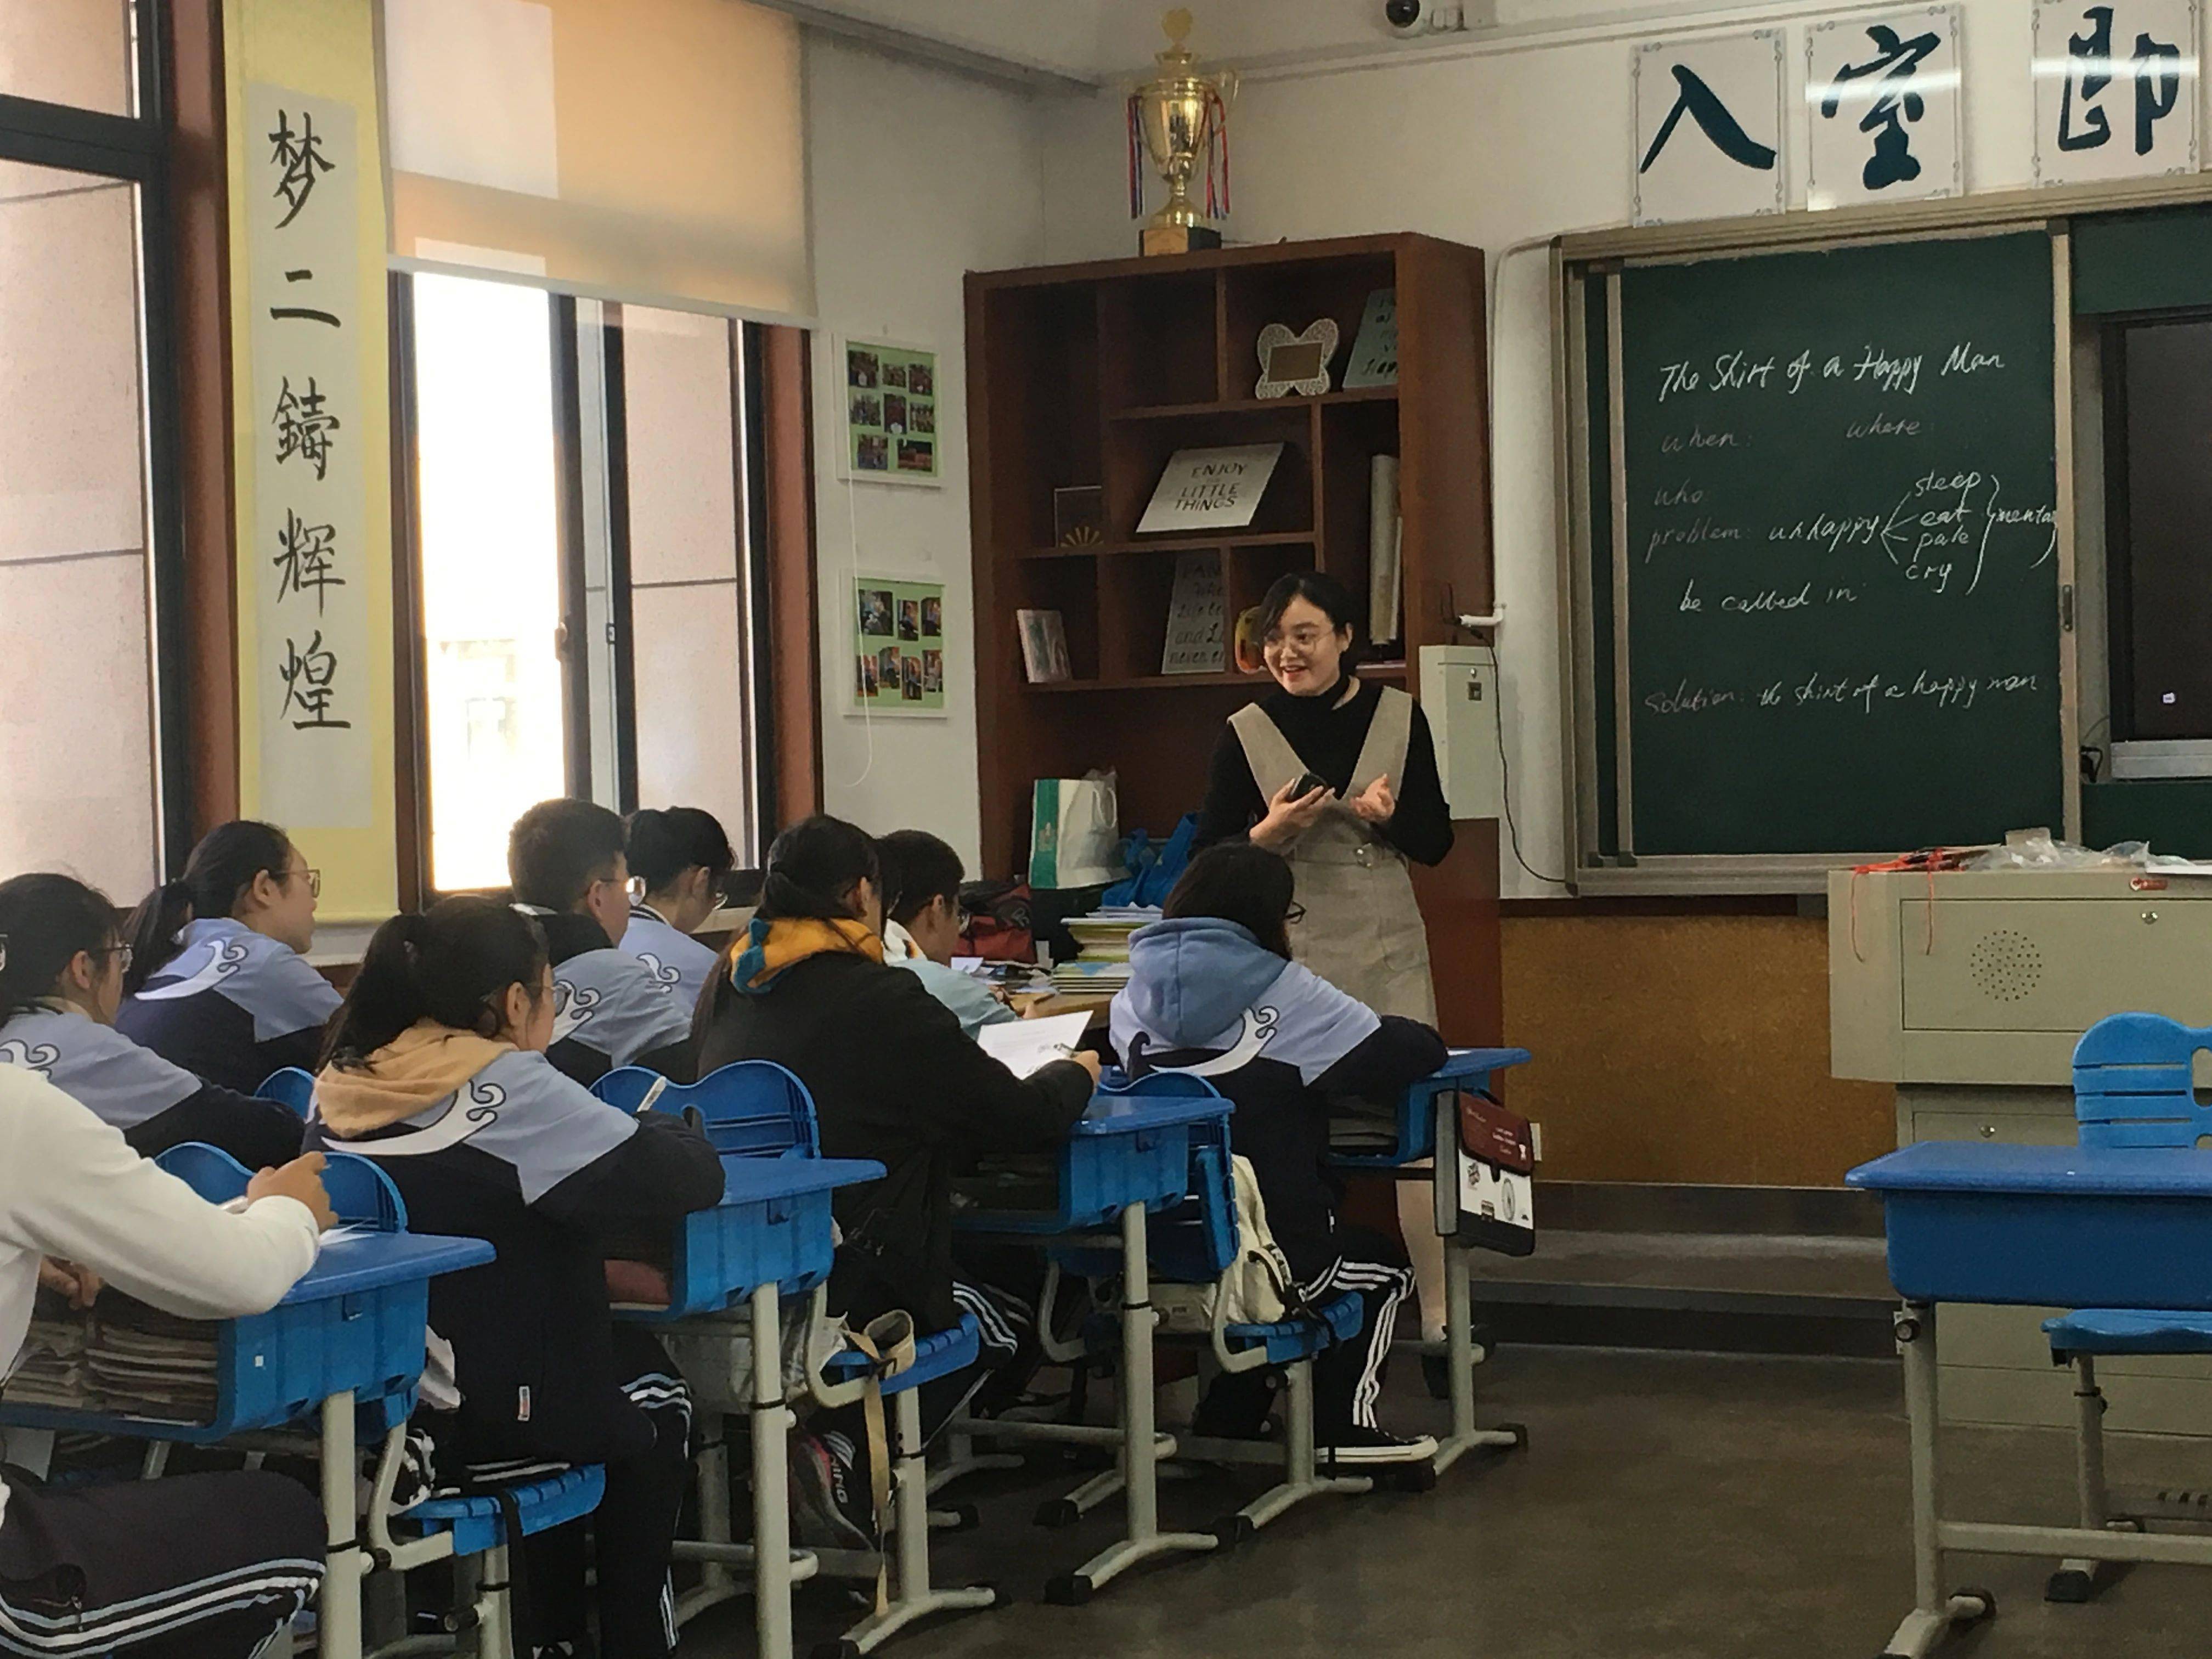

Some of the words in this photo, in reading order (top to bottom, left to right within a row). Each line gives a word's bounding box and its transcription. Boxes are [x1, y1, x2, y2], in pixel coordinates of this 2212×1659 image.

[1658, 360, 1700, 402] The
[1709, 350, 1775, 391] Shirt
[1787, 349, 1811, 394] of
[1823, 356, 1844, 378] a
[1854, 345, 1923, 394] Happy
[1940, 342, 2006, 376] Man
[1190, 462, 1248, 479] ENJOY
[1175, 495, 1238, 511] THINGS
[1181, 482, 1240, 498] LITTLE
[1920, 504, 1972, 527] eat
[1912, 524, 1970, 563] pale
[1905, 562, 1953, 593] cry
[1680, 578, 1702, 612] be
[1721, 582, 1810, 613] called
[1911, 669, 1978, 709] happy
